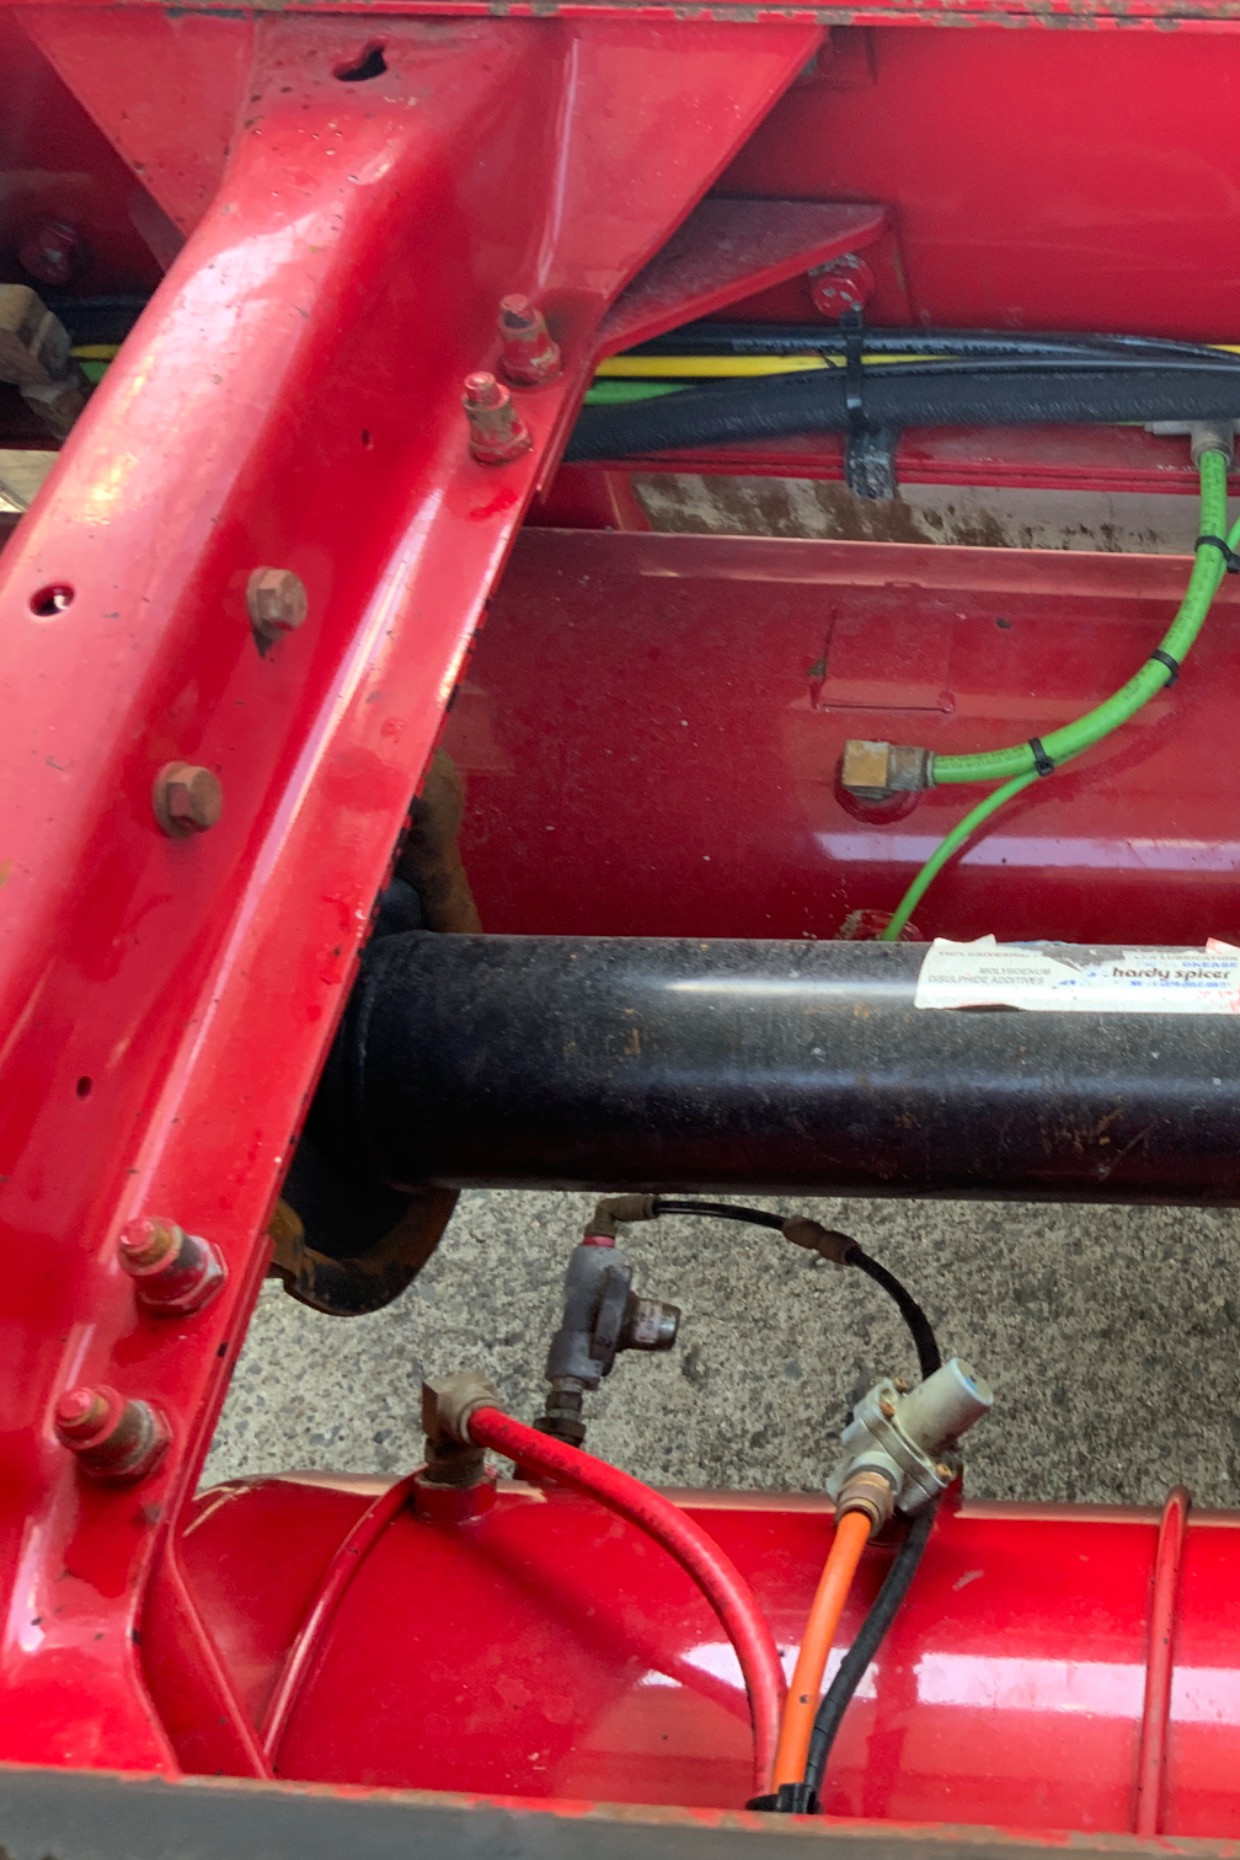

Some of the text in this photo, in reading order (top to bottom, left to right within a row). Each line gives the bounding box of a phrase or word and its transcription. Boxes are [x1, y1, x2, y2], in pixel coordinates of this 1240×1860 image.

[979, 967, 1051, 976] MOLYBDENUM
[1112, 966, 1231, 982] hardy spicer
[928, 975, 1045, 985] DISULPHIDE ADDITIVES
